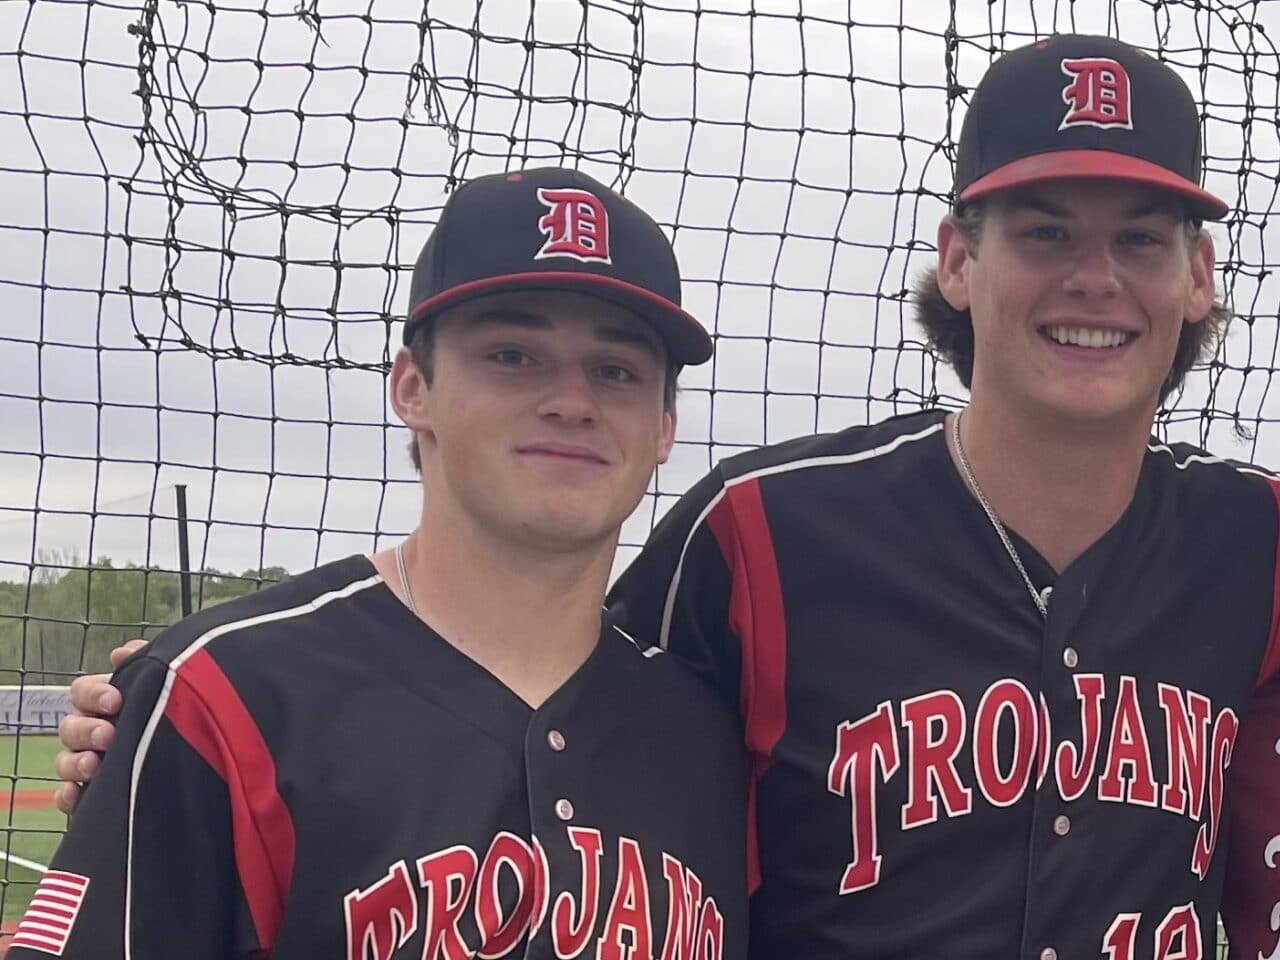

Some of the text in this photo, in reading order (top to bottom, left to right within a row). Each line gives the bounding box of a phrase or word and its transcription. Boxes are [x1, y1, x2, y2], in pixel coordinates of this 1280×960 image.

[1058, 57, 1134, 131] D
[533, 187, 612, 265] D
[827, 673, 1240, 895] TROJANS
